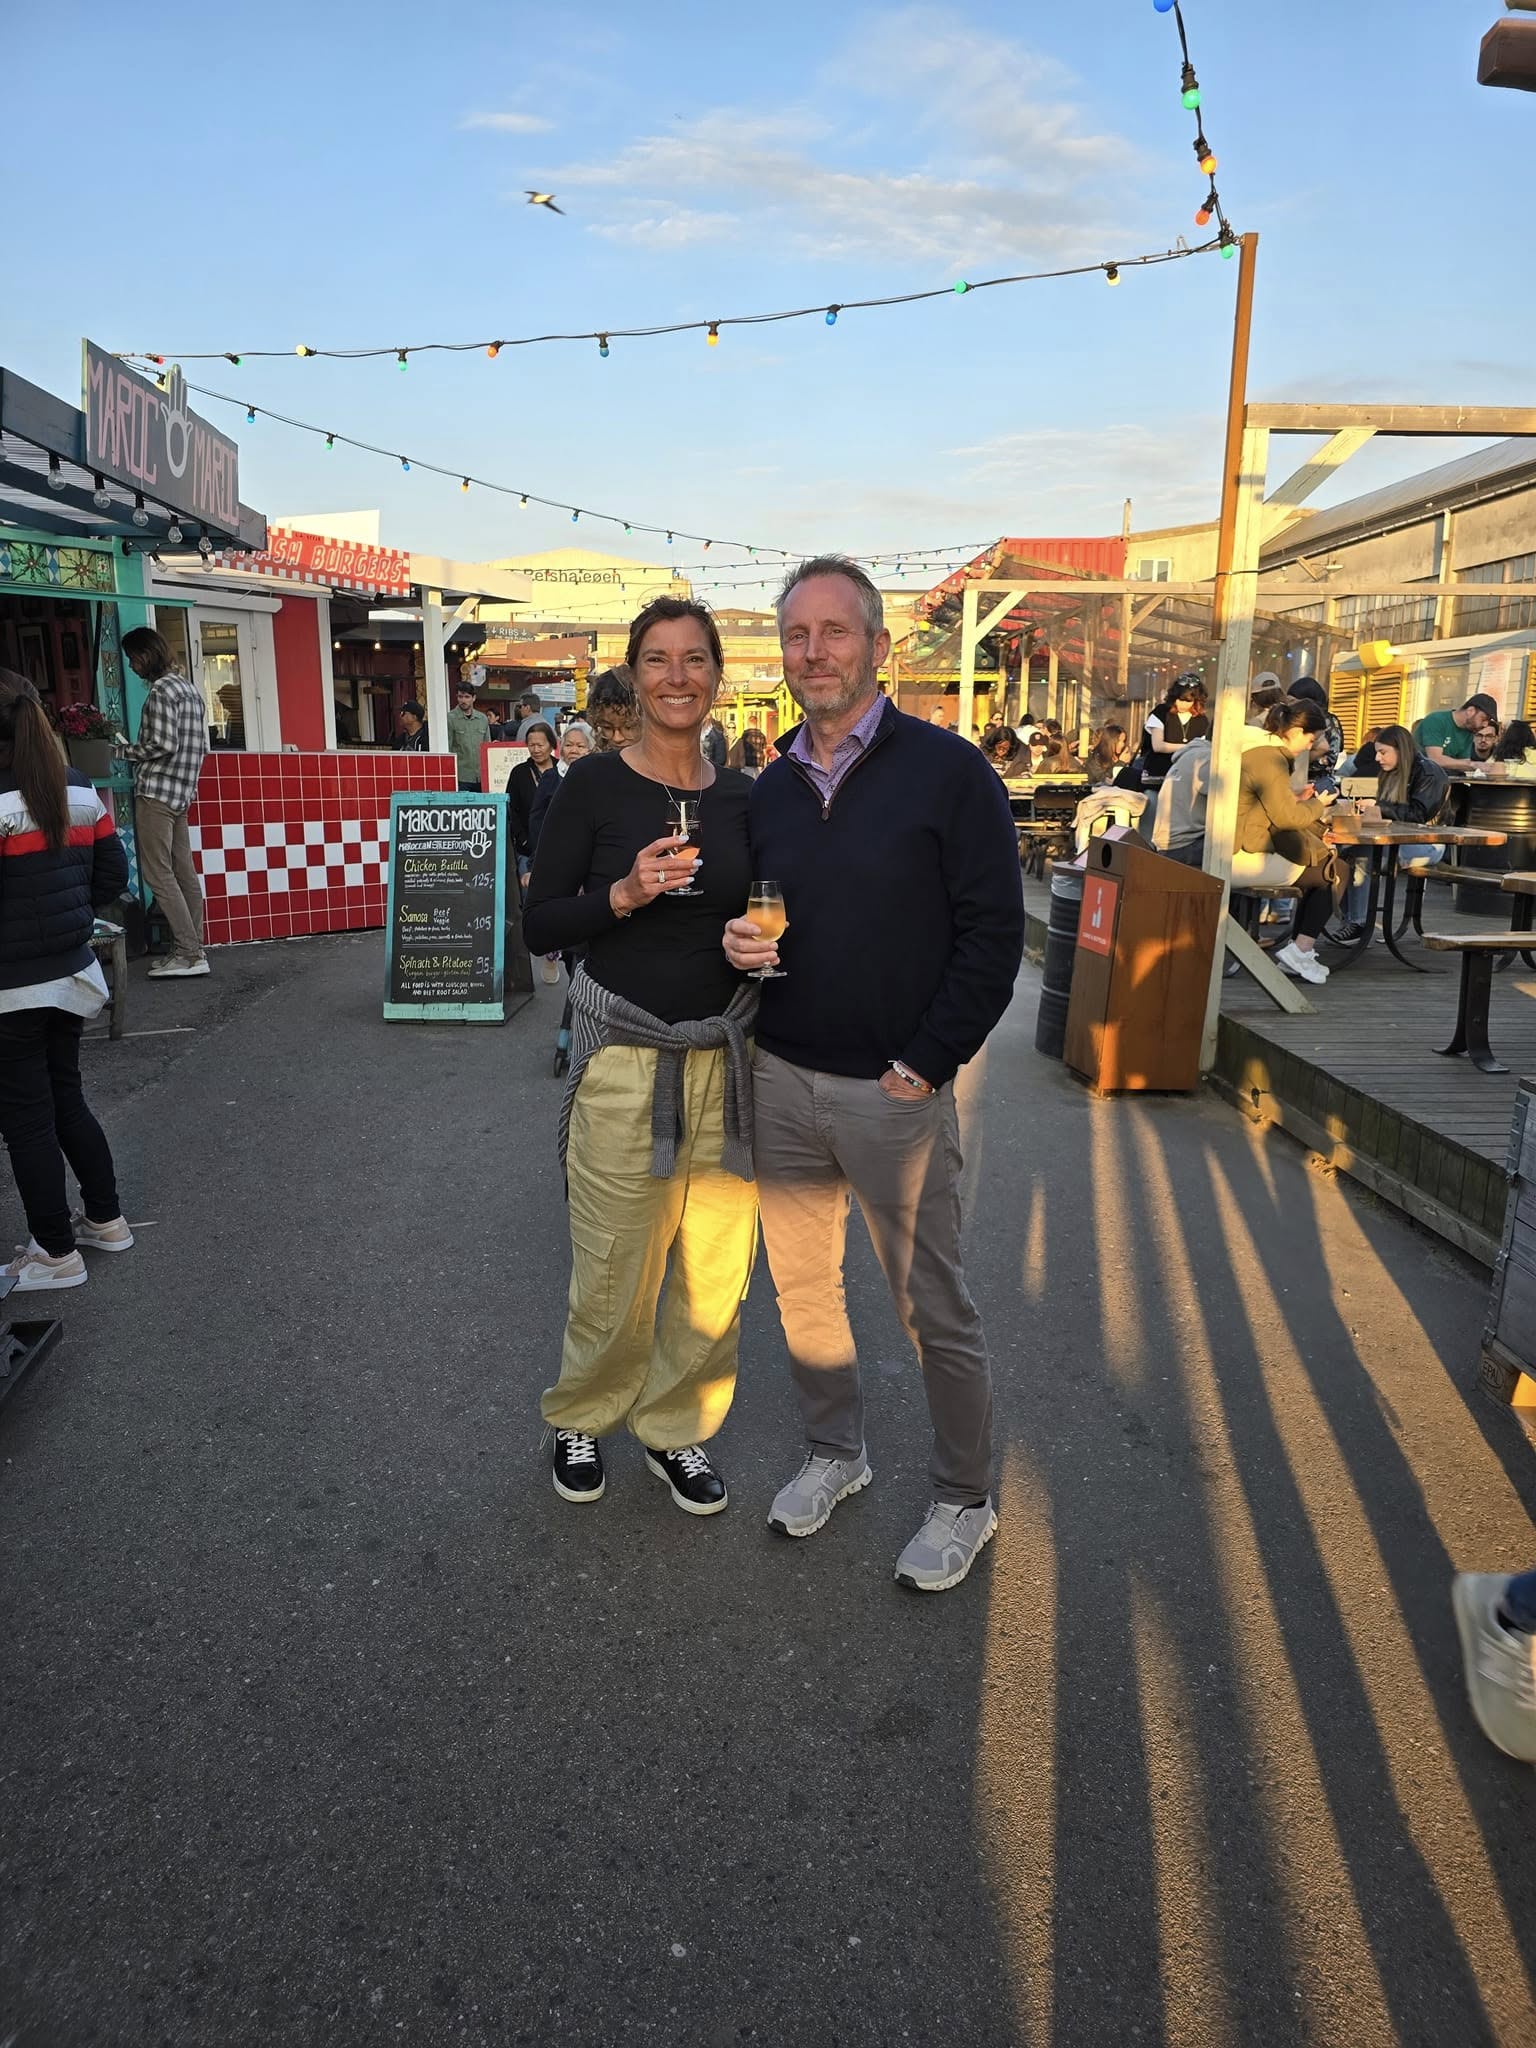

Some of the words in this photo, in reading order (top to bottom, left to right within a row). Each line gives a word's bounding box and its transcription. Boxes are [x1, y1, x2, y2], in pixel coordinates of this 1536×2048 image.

[86, 353, 160, 486] MAROC
[193, 423, 240, 527] MAROC
[310, 545, 404, 583] BURGERS
[499, 627, 519, 637] RIBS
[404, 858, 437, 873] Chicken
[399, 904, 429, 923] Samosa
[433, 907, 451, 917] Beef
[473, 915, 492, 931] 105
[400, 954, 431, 970] Spinach
[432, 956, 441, 968] &
[400, 982, 411, 990] ALL
